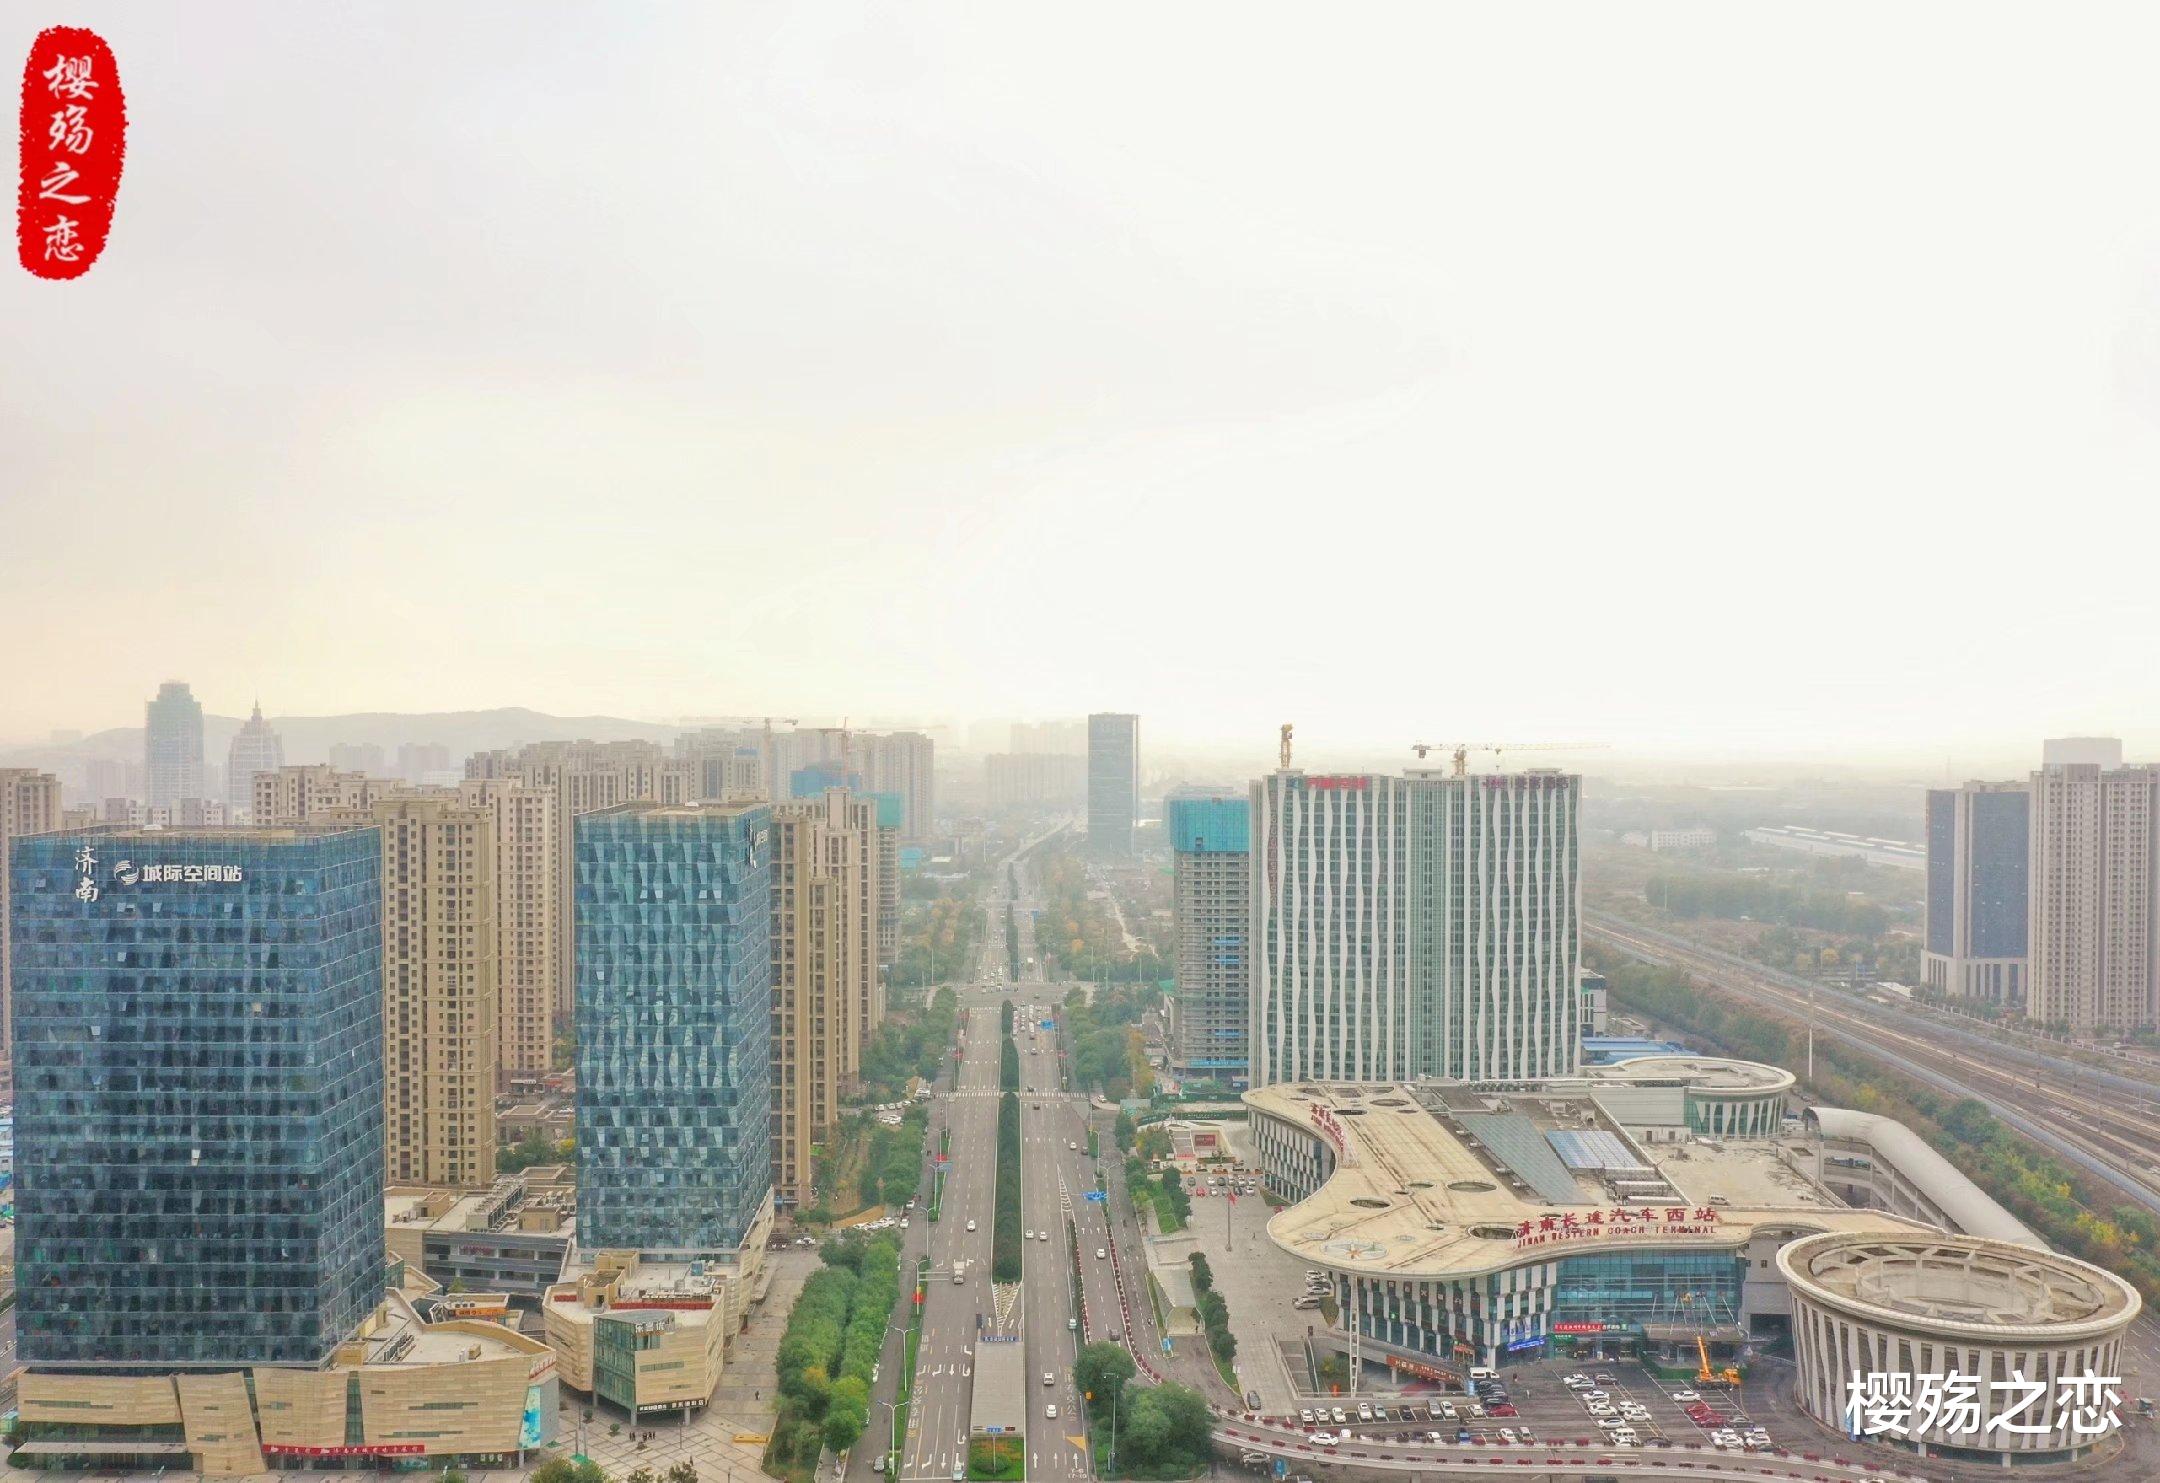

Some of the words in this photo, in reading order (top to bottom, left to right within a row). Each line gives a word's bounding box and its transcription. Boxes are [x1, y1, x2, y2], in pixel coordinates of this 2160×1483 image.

[75, 846, 99, 903] 济南
[142, 865, 242, 882] 城际空间站
[1552, 1228, 1600, 1240] WESTERN
